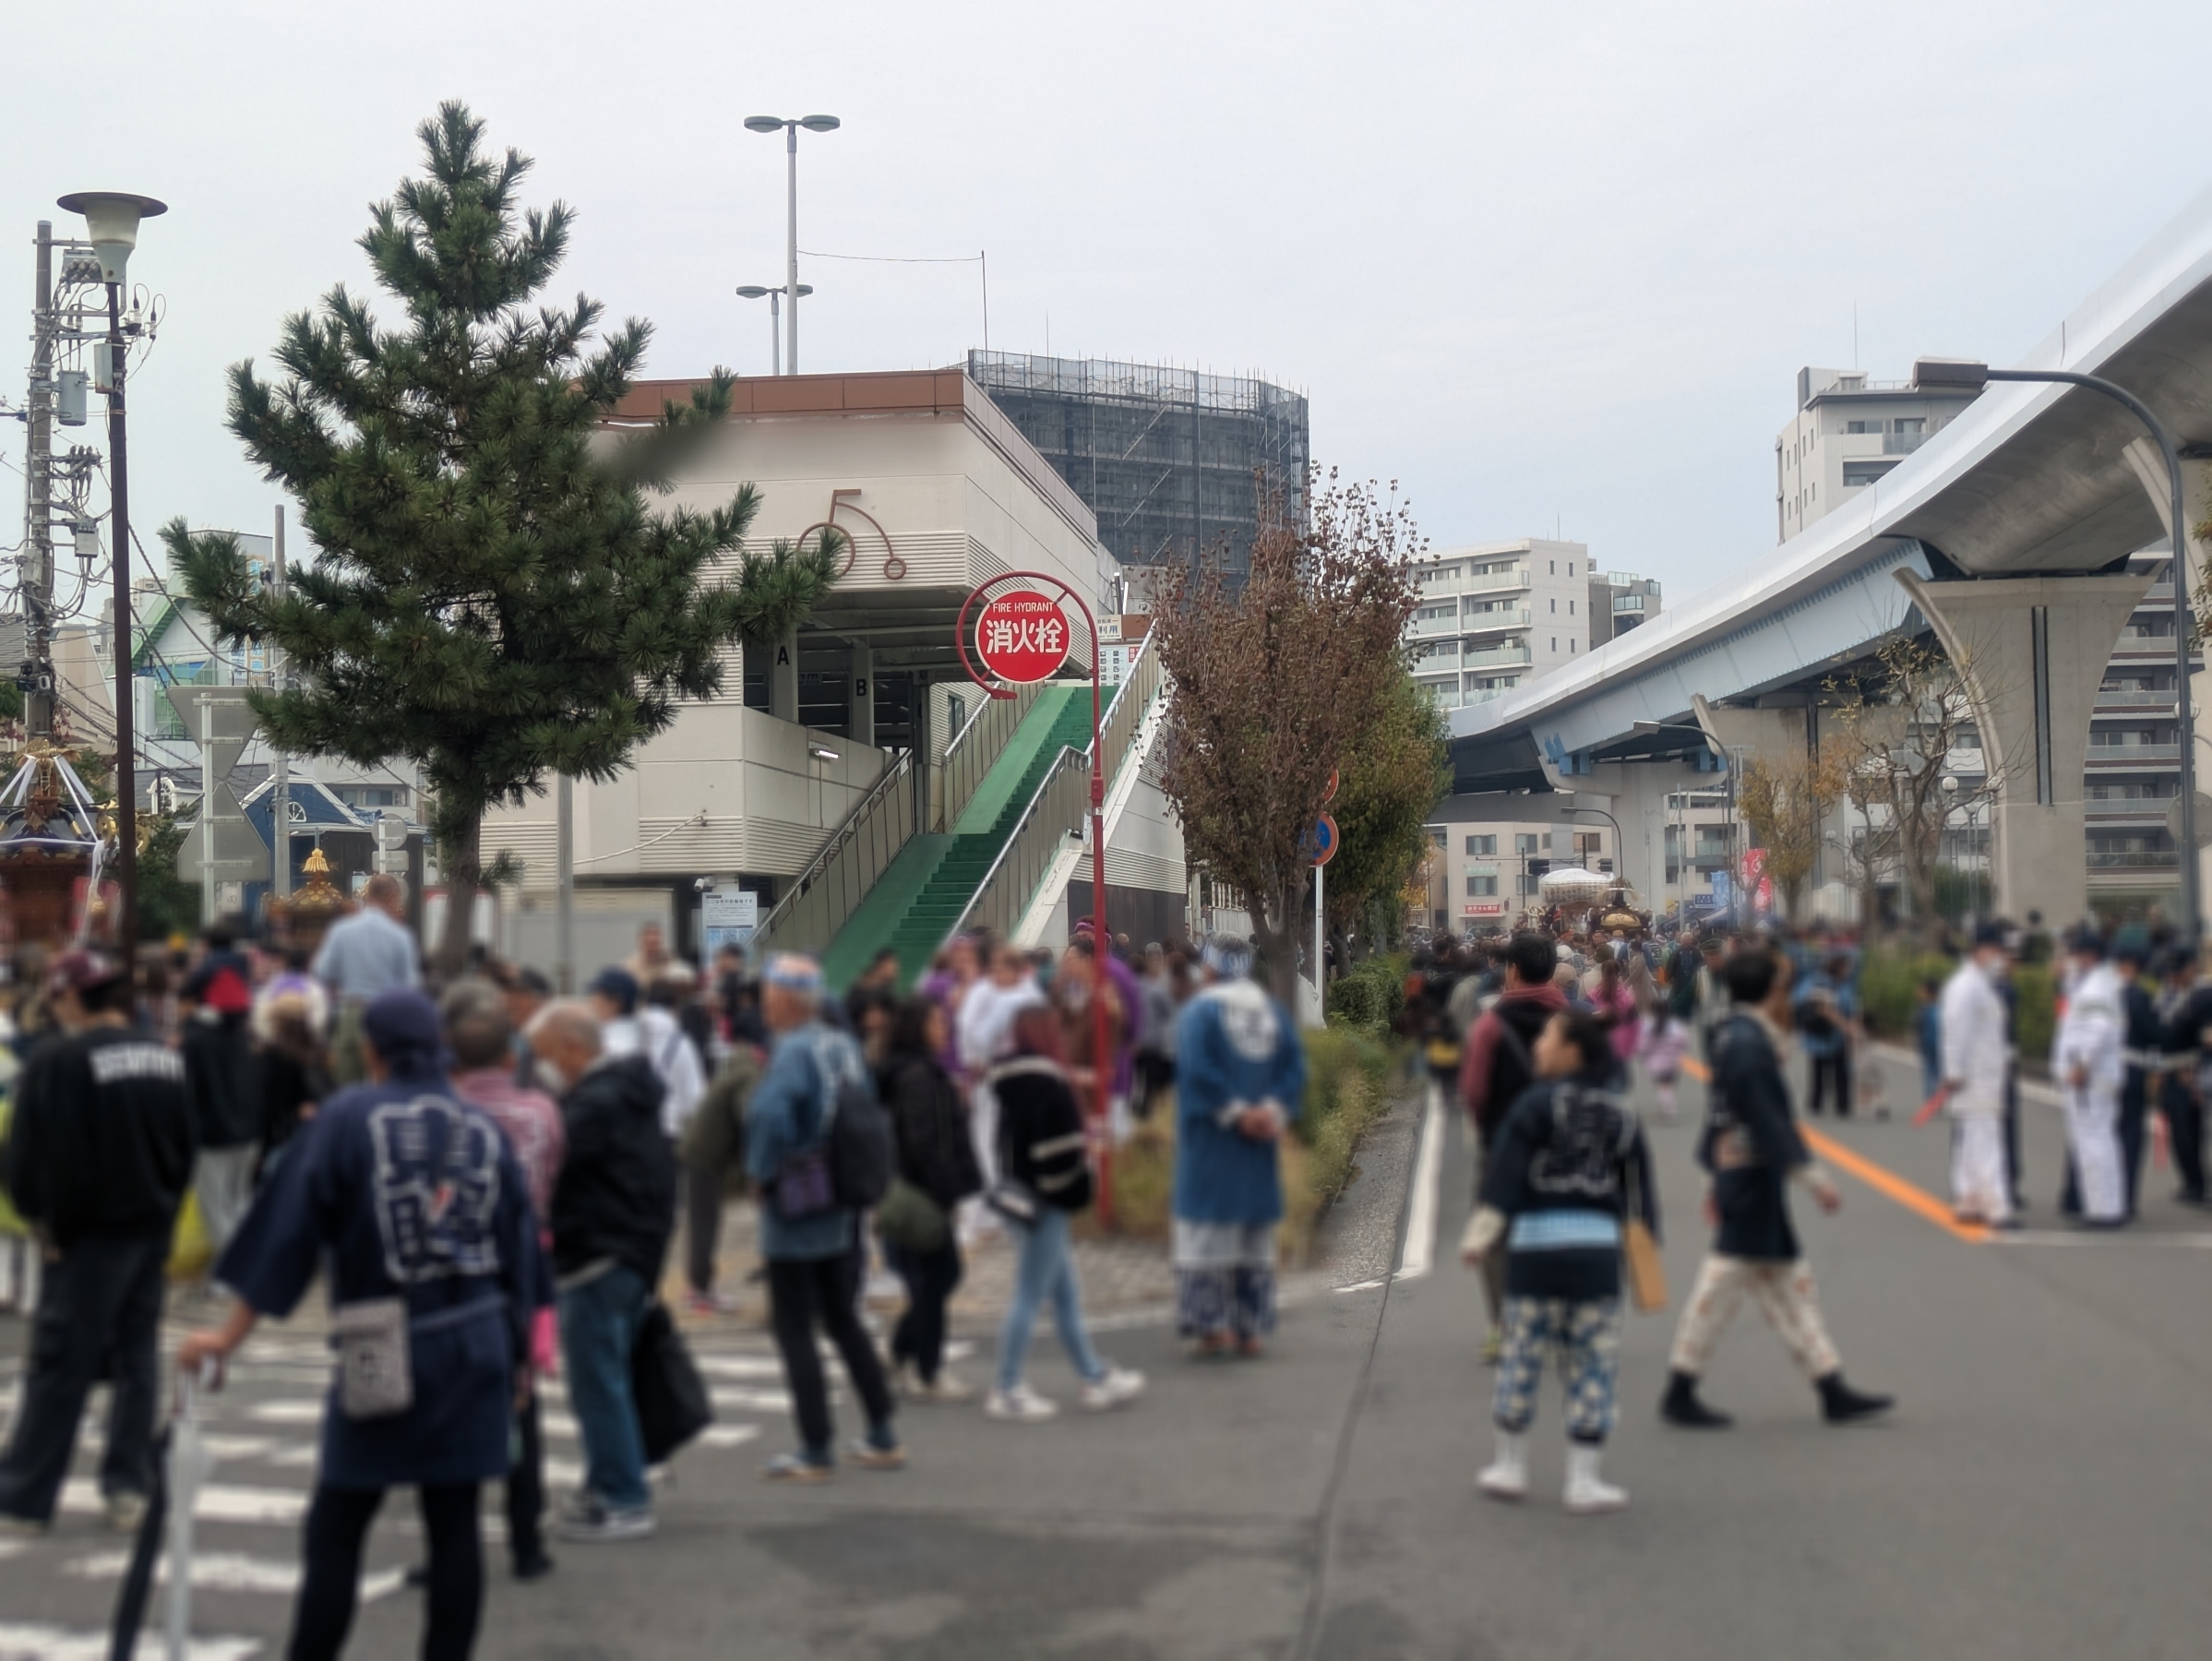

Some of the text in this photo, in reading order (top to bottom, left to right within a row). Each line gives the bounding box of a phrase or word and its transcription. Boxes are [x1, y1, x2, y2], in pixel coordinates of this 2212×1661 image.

[993, 602, 1054, 613] FIRE HYDRANT
[986, 617, 1063, 654] 消火栓
[776, 645, 790, 665] A
[855, 678, 867, 697] B
